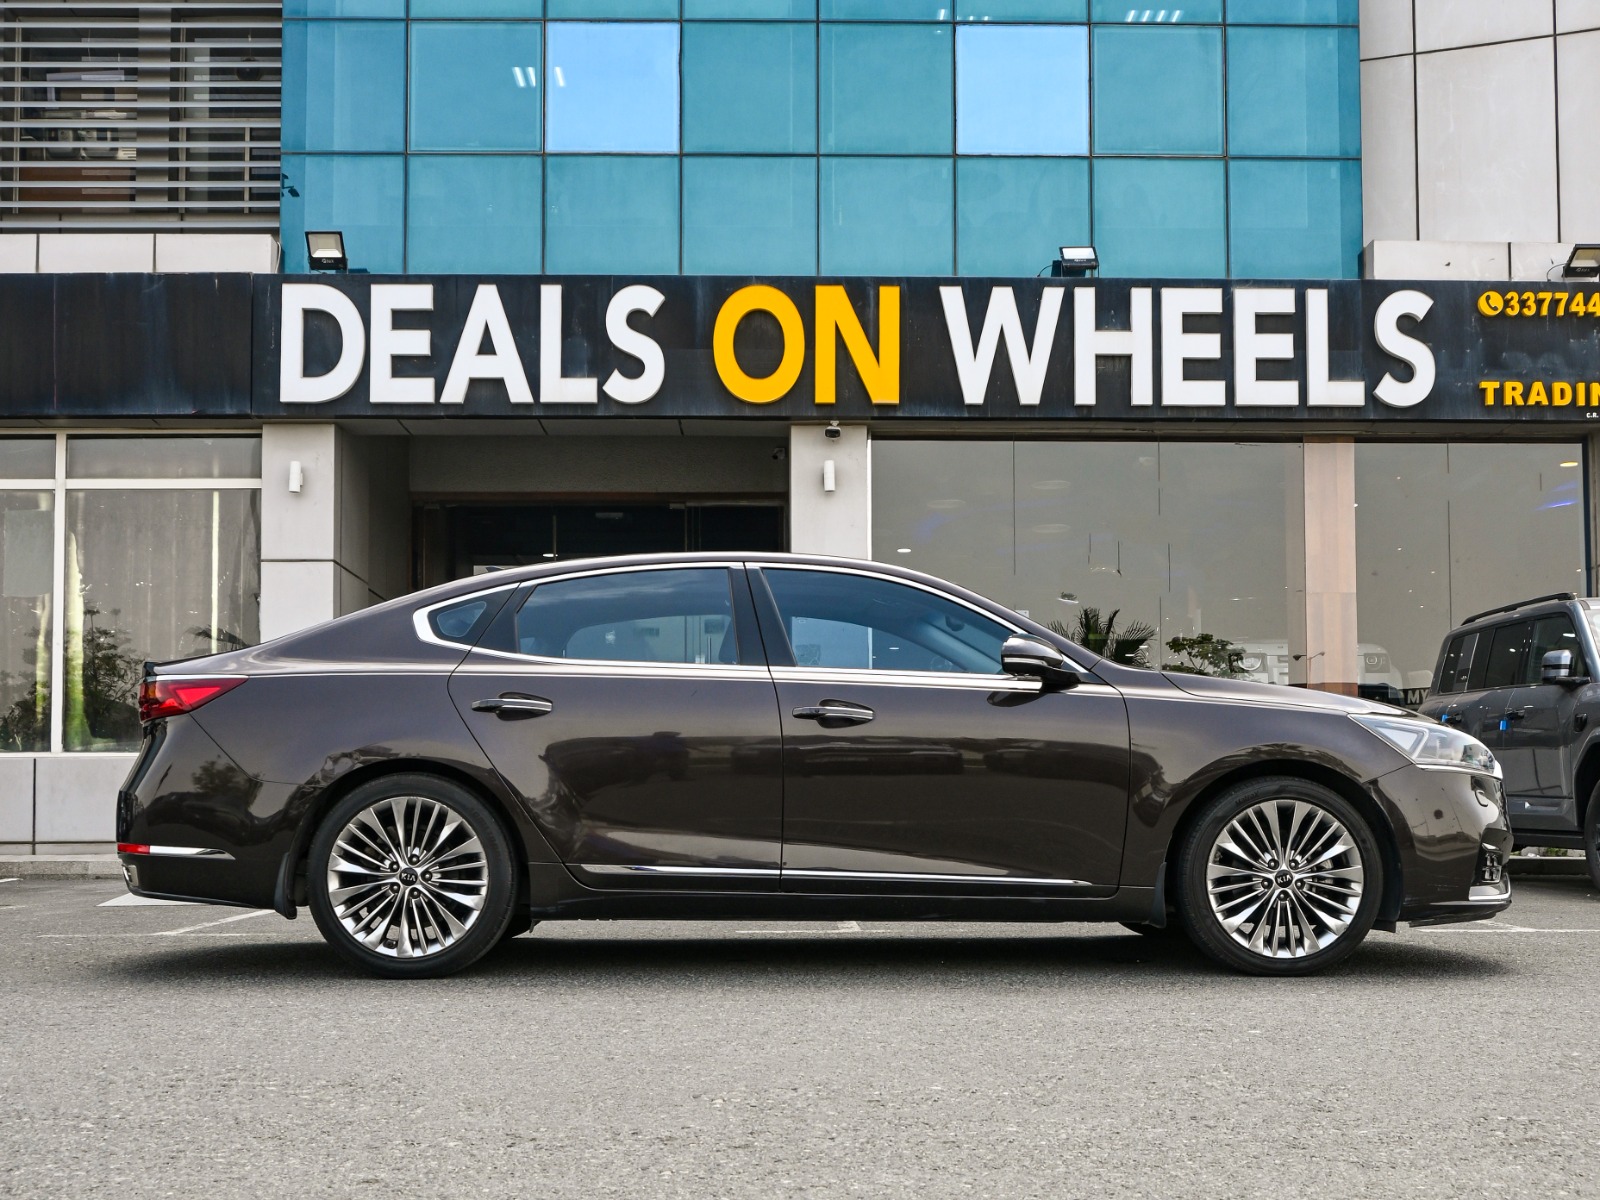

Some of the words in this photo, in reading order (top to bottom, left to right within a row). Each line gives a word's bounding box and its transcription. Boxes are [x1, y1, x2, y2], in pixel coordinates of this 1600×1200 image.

[279, 283, 666, 405] DEALS
[713, 284, 901, 405] ON
[939, 285, 1436, 407] WHEELS
[400, 872, 416, 882] KIA
[1276, 874, 1292, 884] KIA
